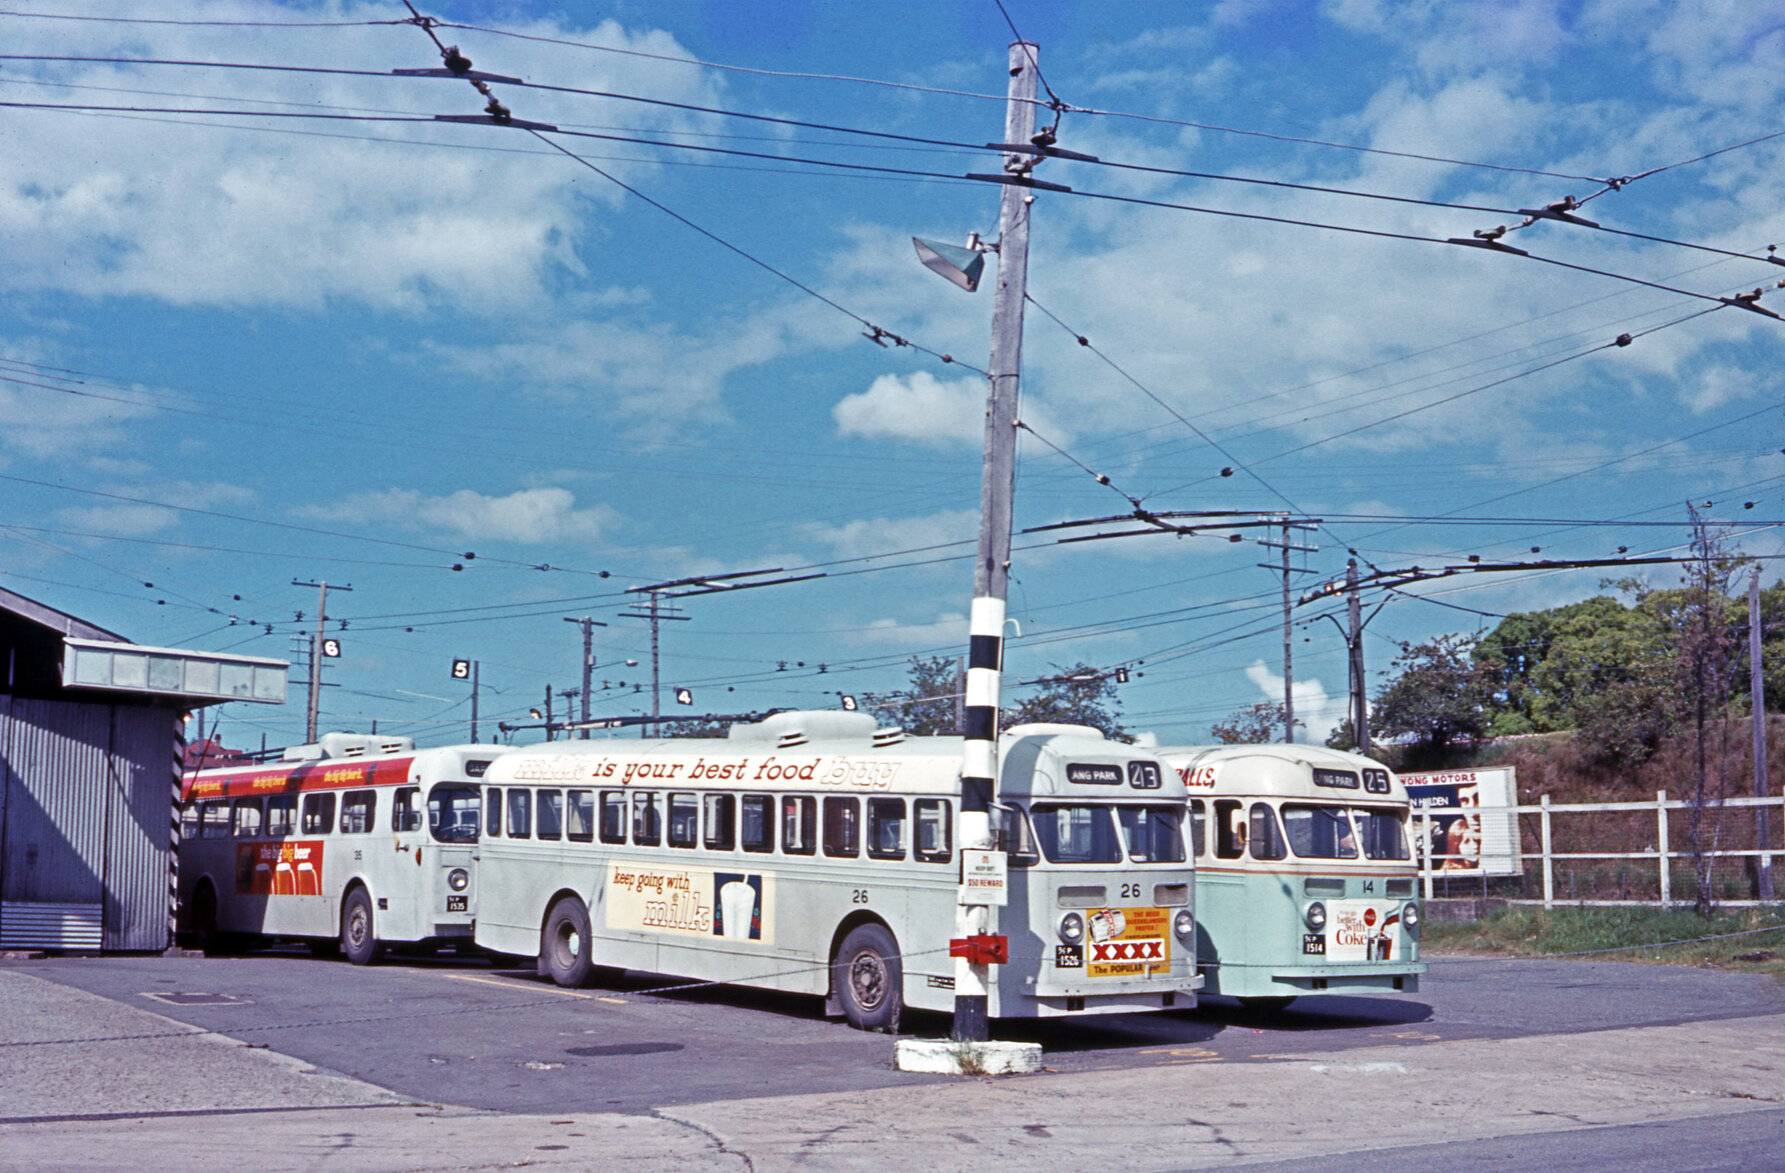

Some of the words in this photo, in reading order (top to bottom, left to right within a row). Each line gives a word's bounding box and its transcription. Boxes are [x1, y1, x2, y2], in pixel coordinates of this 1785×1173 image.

[324, 640, 339, 657] 6
[454, 662, 468, 678] 5
[677, 690, 692, 704] 4
[843, 696, 856, 710] 3
[592, 757, 617, 777] is
[622, 763, 684, 785] your
[688, 758, 749, 780] best
[753, 757, 822, 780] food
[821, 756, 901, 791] buy
[1093, 770, 1118, 781] PARK
[1432, 772, 1477, 783] MOTORS
[1365, 771, 1388, 792] 25
[283, 843, 293, 862] big
[294, 843, 311, 859] beer
[613, 866, 635, 891] keep
[636, 872, 665, 895] going
[667, 871, 690, 890] with
[968, 879, 979, 887] $50
[980, 879, 1004, 888] REWARD
[1362, 880, 1374, 893] 14
[852, 889, 869, 904] 26
[1120, 883, 1141, 898] 26
[643, 890, 710, 931] milk
[1346, 920, 1366, 932] with
[1336, 929, 1368, 945] Coke
[1092, 941, 1163, 961] XXXX
[1306, 943, 1323, 953] 1514
[1060, 955, 1079, 966] 1526
[1110, 962, 1143, 973] POPULAR
